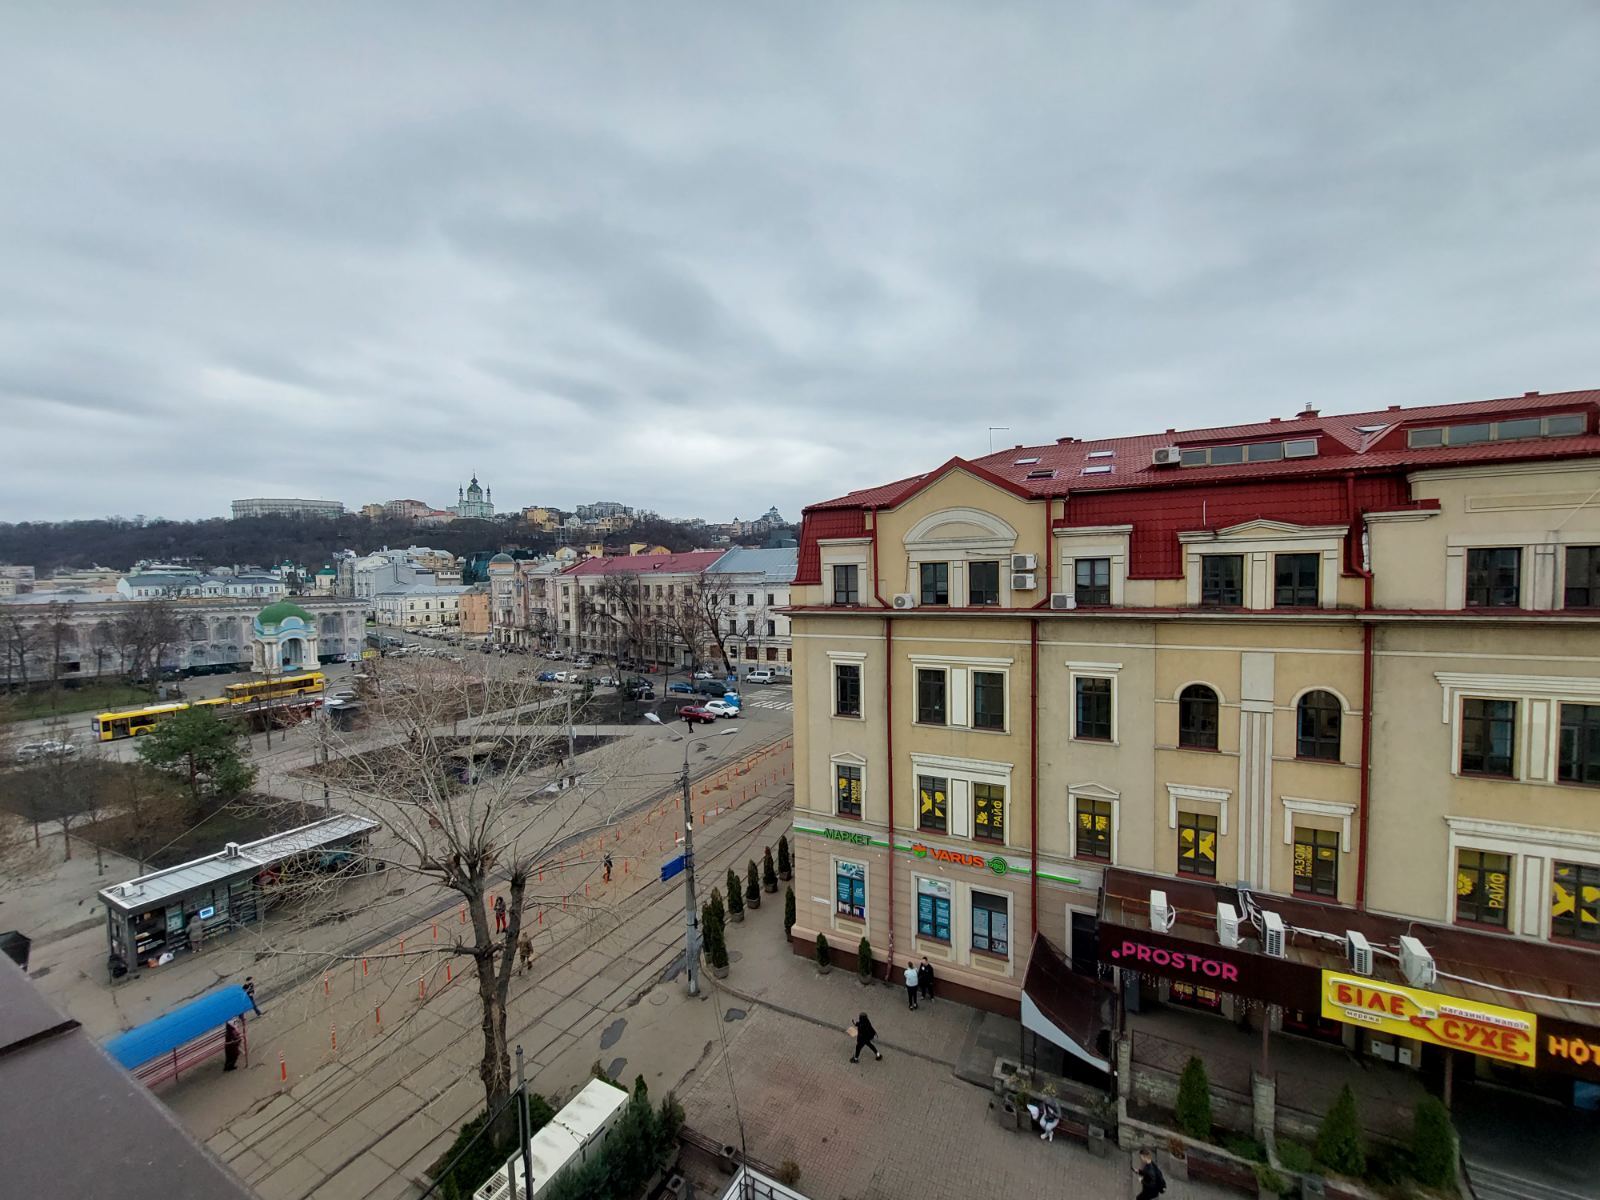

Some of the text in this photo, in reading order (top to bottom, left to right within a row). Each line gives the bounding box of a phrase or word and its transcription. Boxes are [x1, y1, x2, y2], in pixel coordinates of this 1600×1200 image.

[991, 800, 1003, 827] РАЙФ
[824, 827, 872, 846] МАРКЕТ
[930, 848, 985, 868] VARUS
[1294, 844, 1306, 876] РАЗОМ
[1485, 873, 1505, 909] РАЙФ
[1338, 984, 1406, 1016] БІЛЕ
[1443, 1019, 1518, 1053] СУХЕ
